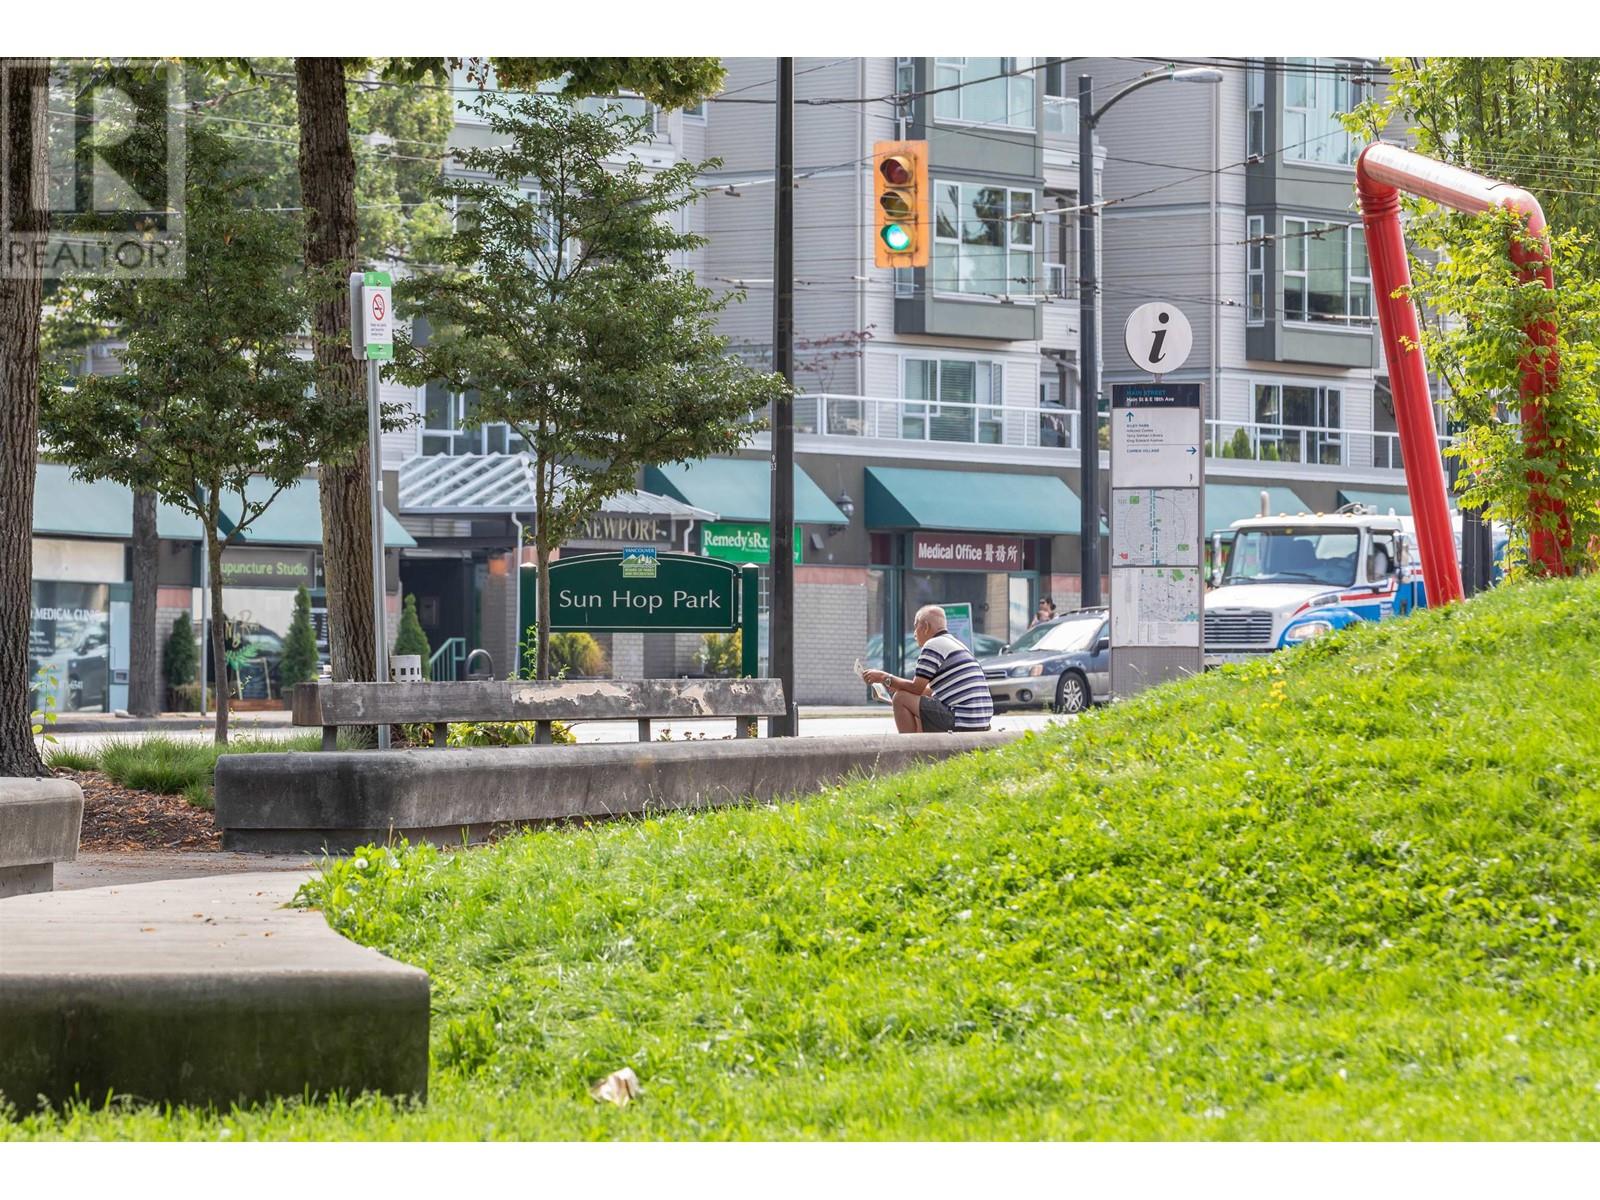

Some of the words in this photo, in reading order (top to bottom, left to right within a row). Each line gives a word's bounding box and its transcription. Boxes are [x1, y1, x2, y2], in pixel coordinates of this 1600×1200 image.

[582, 516, 658, 541] NEWPORT
[918, 542, 954, 559] Medical
[955, 543, 982, 560] Office
[209, 563, 273, 576] upuncture
[276, 562, 308, 576] Studio
[559, 590, 602, 608] Sun
[612, 590, 663, 614] Hop
[673, 589, 721, 608] Park
[35, 608, 72, 621] MEDICAL
